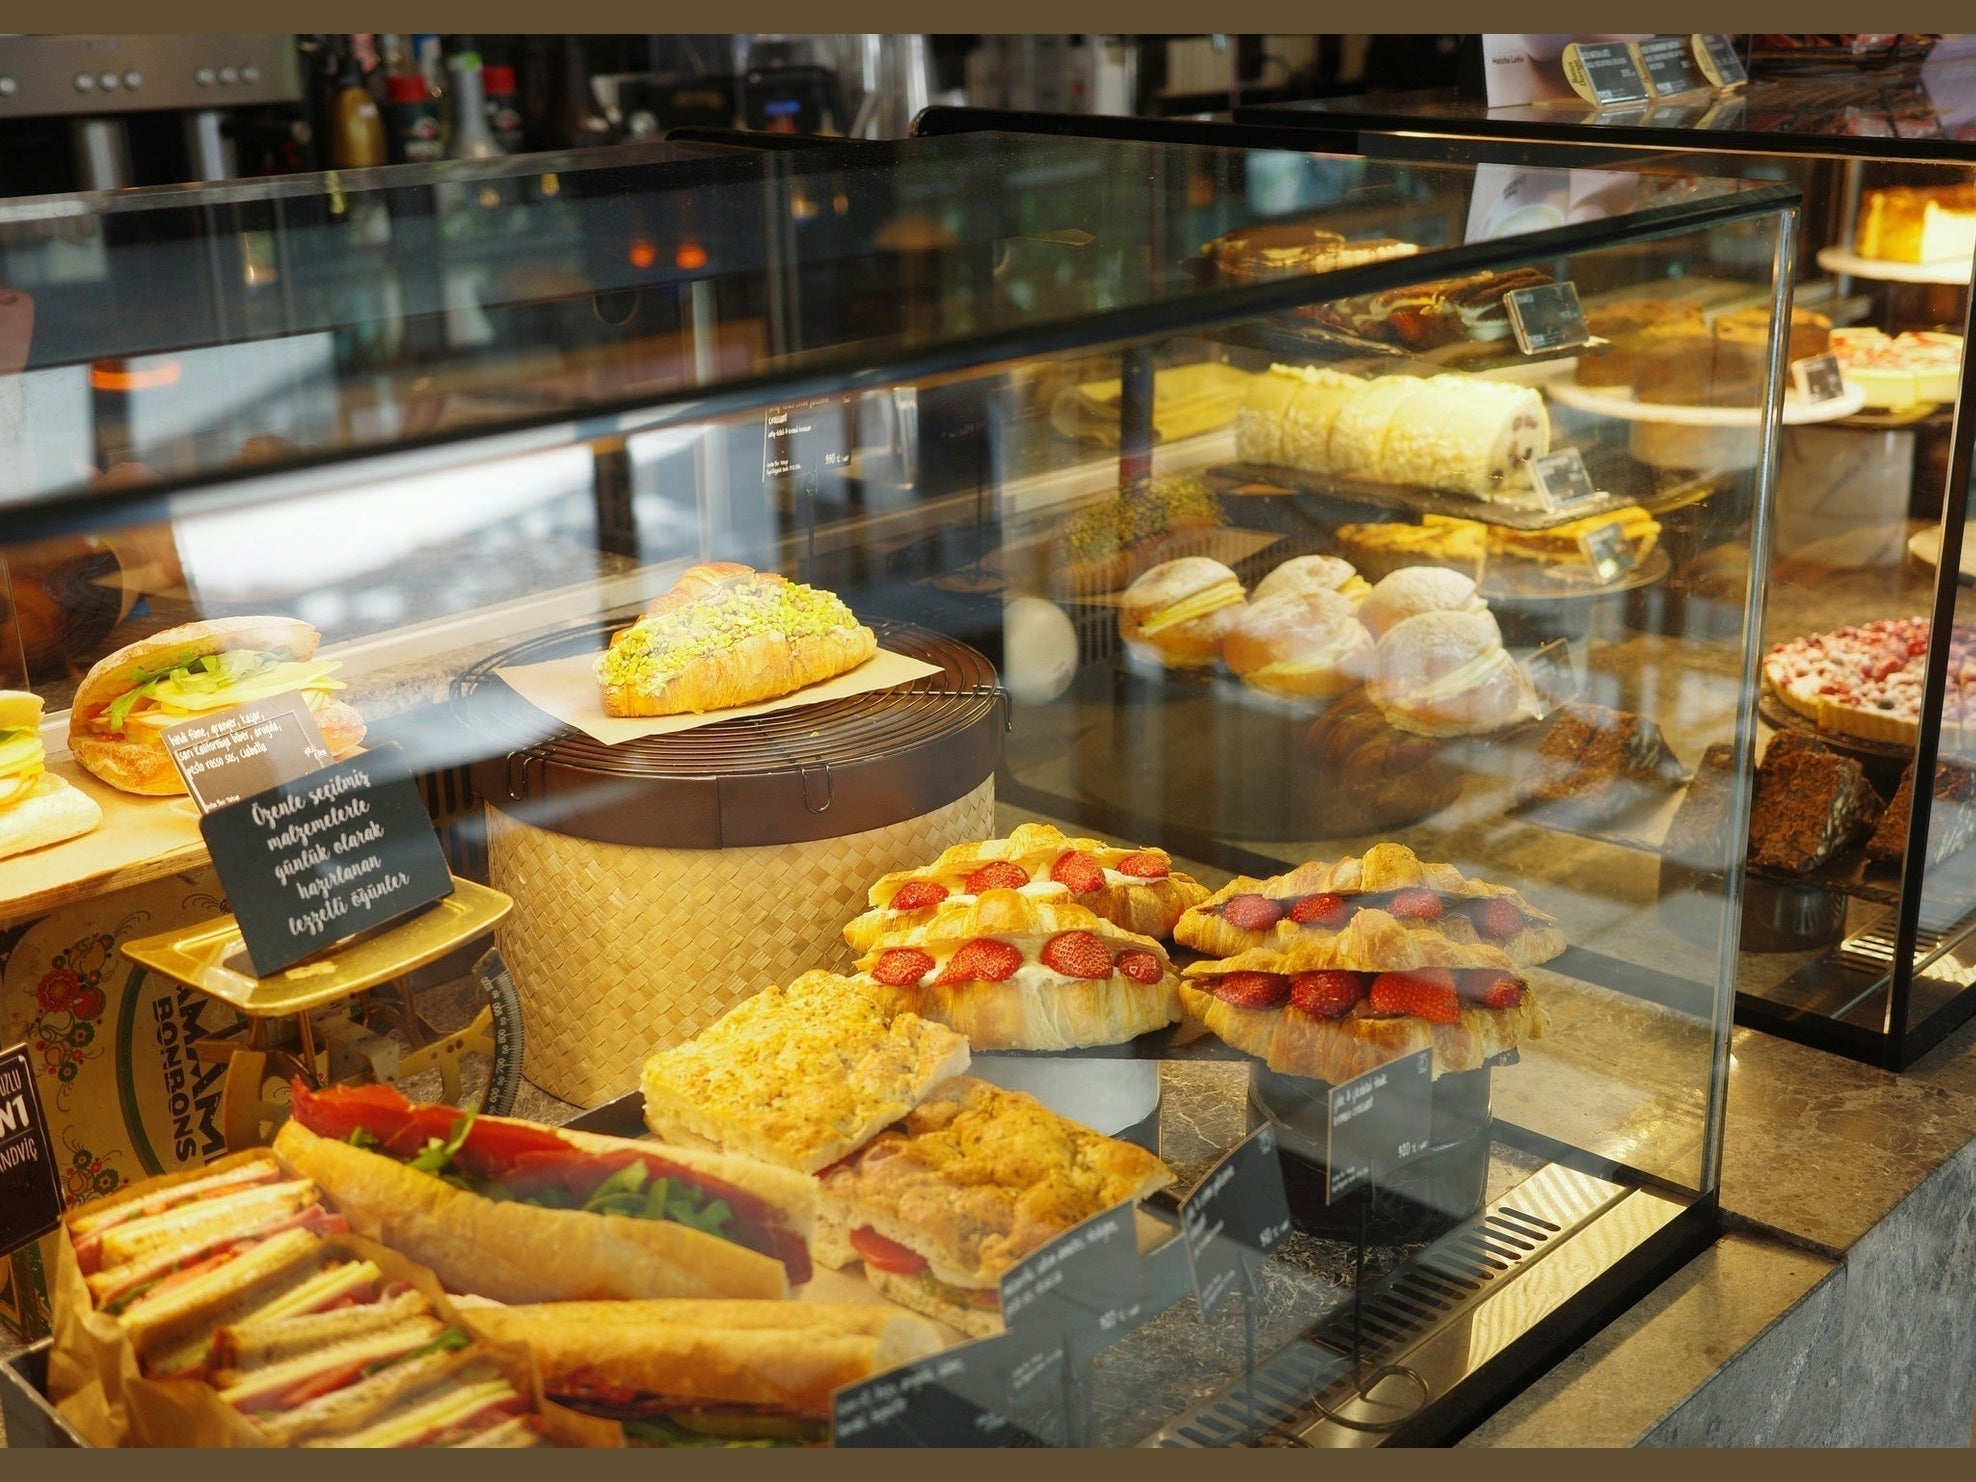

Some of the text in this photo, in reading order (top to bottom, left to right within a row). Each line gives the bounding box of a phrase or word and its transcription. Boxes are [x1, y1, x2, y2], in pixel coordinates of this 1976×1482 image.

[251, 794, 306, 829] Özenle
[308, 769, 371, 805] seçilmiş
[266, 798, 371, 851] malzemelerle
[275, 820, 385, 886] günlük olarak
[296, 855, 382, 899] hazırlanan
[288, 872, 410, 936] lezzetli öğünler
[497, 1028, 507, 1044] 800
[0, 1069, 21, 1097] UZLU
[496, 1057, 506, 1074] 700
[0, 1095, 30, 1138] N1
[489, 1086, 500, 1104] 600
